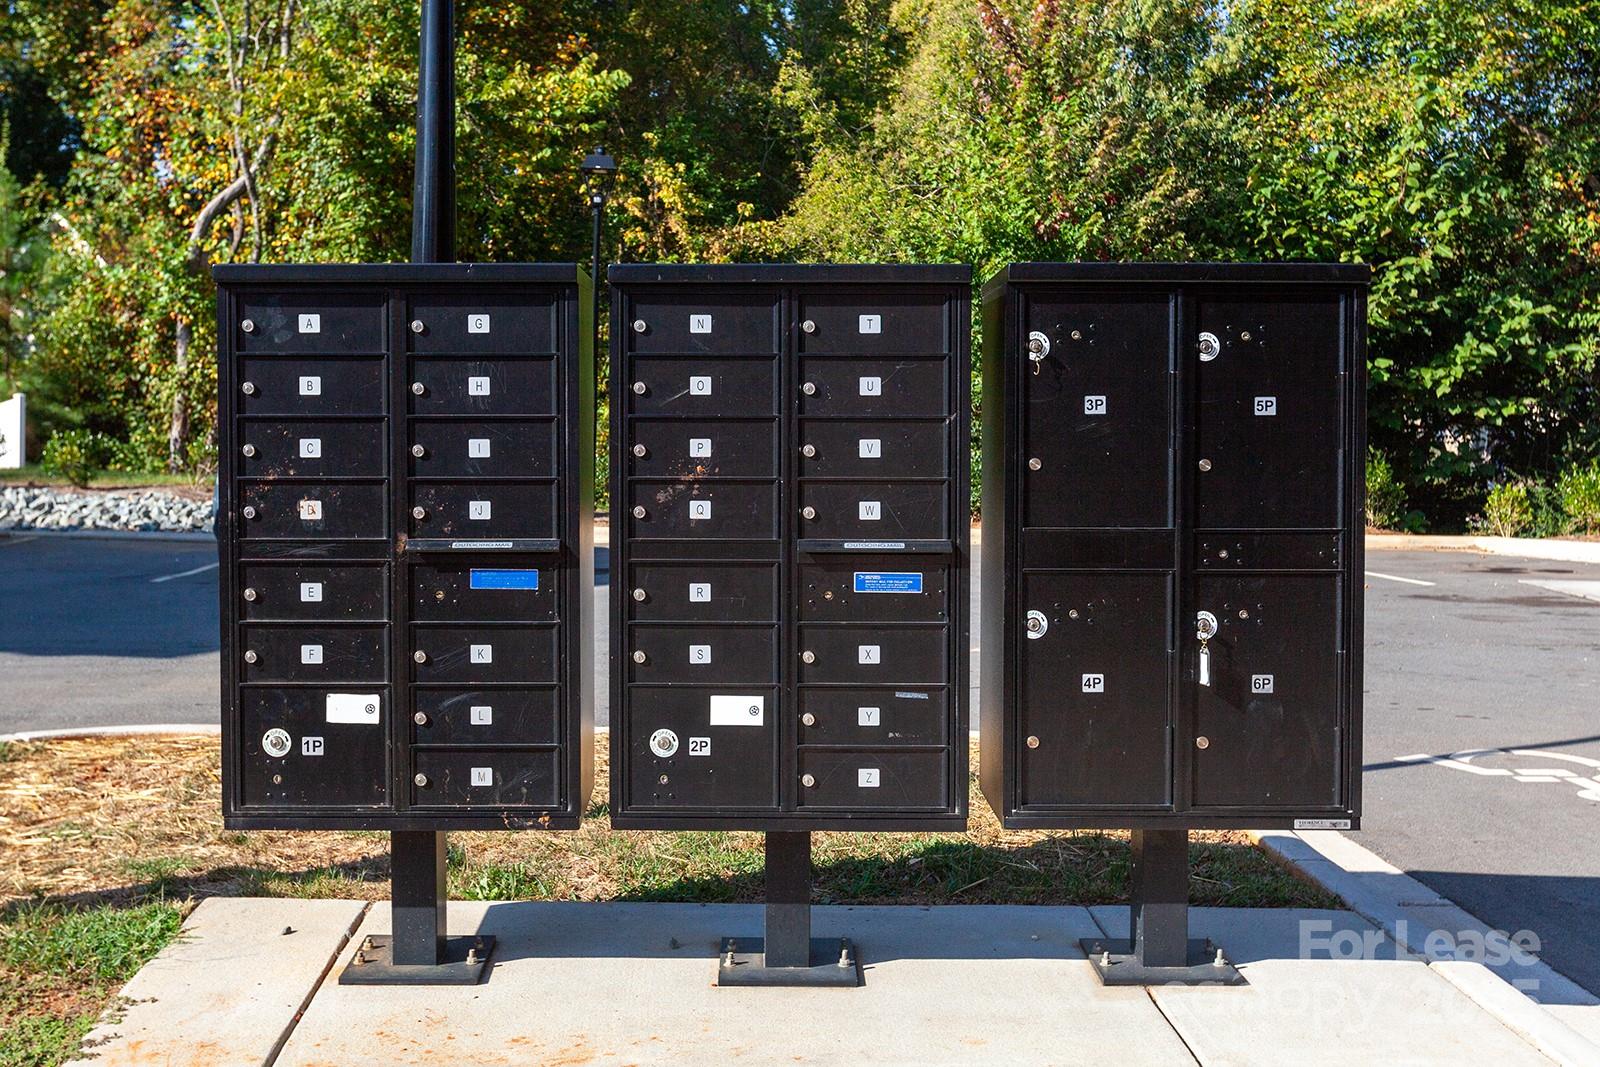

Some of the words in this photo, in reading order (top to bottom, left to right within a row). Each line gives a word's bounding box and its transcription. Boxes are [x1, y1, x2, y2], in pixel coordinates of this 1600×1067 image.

[305, 318, 313, 329] A
[474, 318, 483, 330] G
[697, 318, 705, 329] N
[866, 318, 874, 330] T
[306, 380, 314, 392] B
[475, 380, 483, 392] H
[696, 379, 705, 392] O
[866, 380, 874, 392] U
[1086, 398, 1104, 411] 3P
[1256, 399, 1274, 412] 5P
[306, 442, 314, 454] C
[697, 442, 704, 453] P
[866, 442, 874, 454] V
[307, 504, 315, 516] D
[477, 504, 483, 516] J
[696, 503, 705, 516] Q
[864, 505, 875, 517] W
[308, 586, 315, 598] E
[696, 587, 704, 598] R
[308, 648, 315, 660] F
[477, 648, 485, 660] K
[696, 648, 704, 661] S
[864, 649, 872, 660] X
[1083, 677, 1102, 689] 4P
[1253, 677, 1271, 690] 6P
[478, 710, 485, 721] L
[865, 711, 873, 722] Y
[303, 739, 323, 753] 1P
[690, 740, 709, 752] 2P
[477, 771, 486, 783] M
[865, 772, 873, 784] Z
